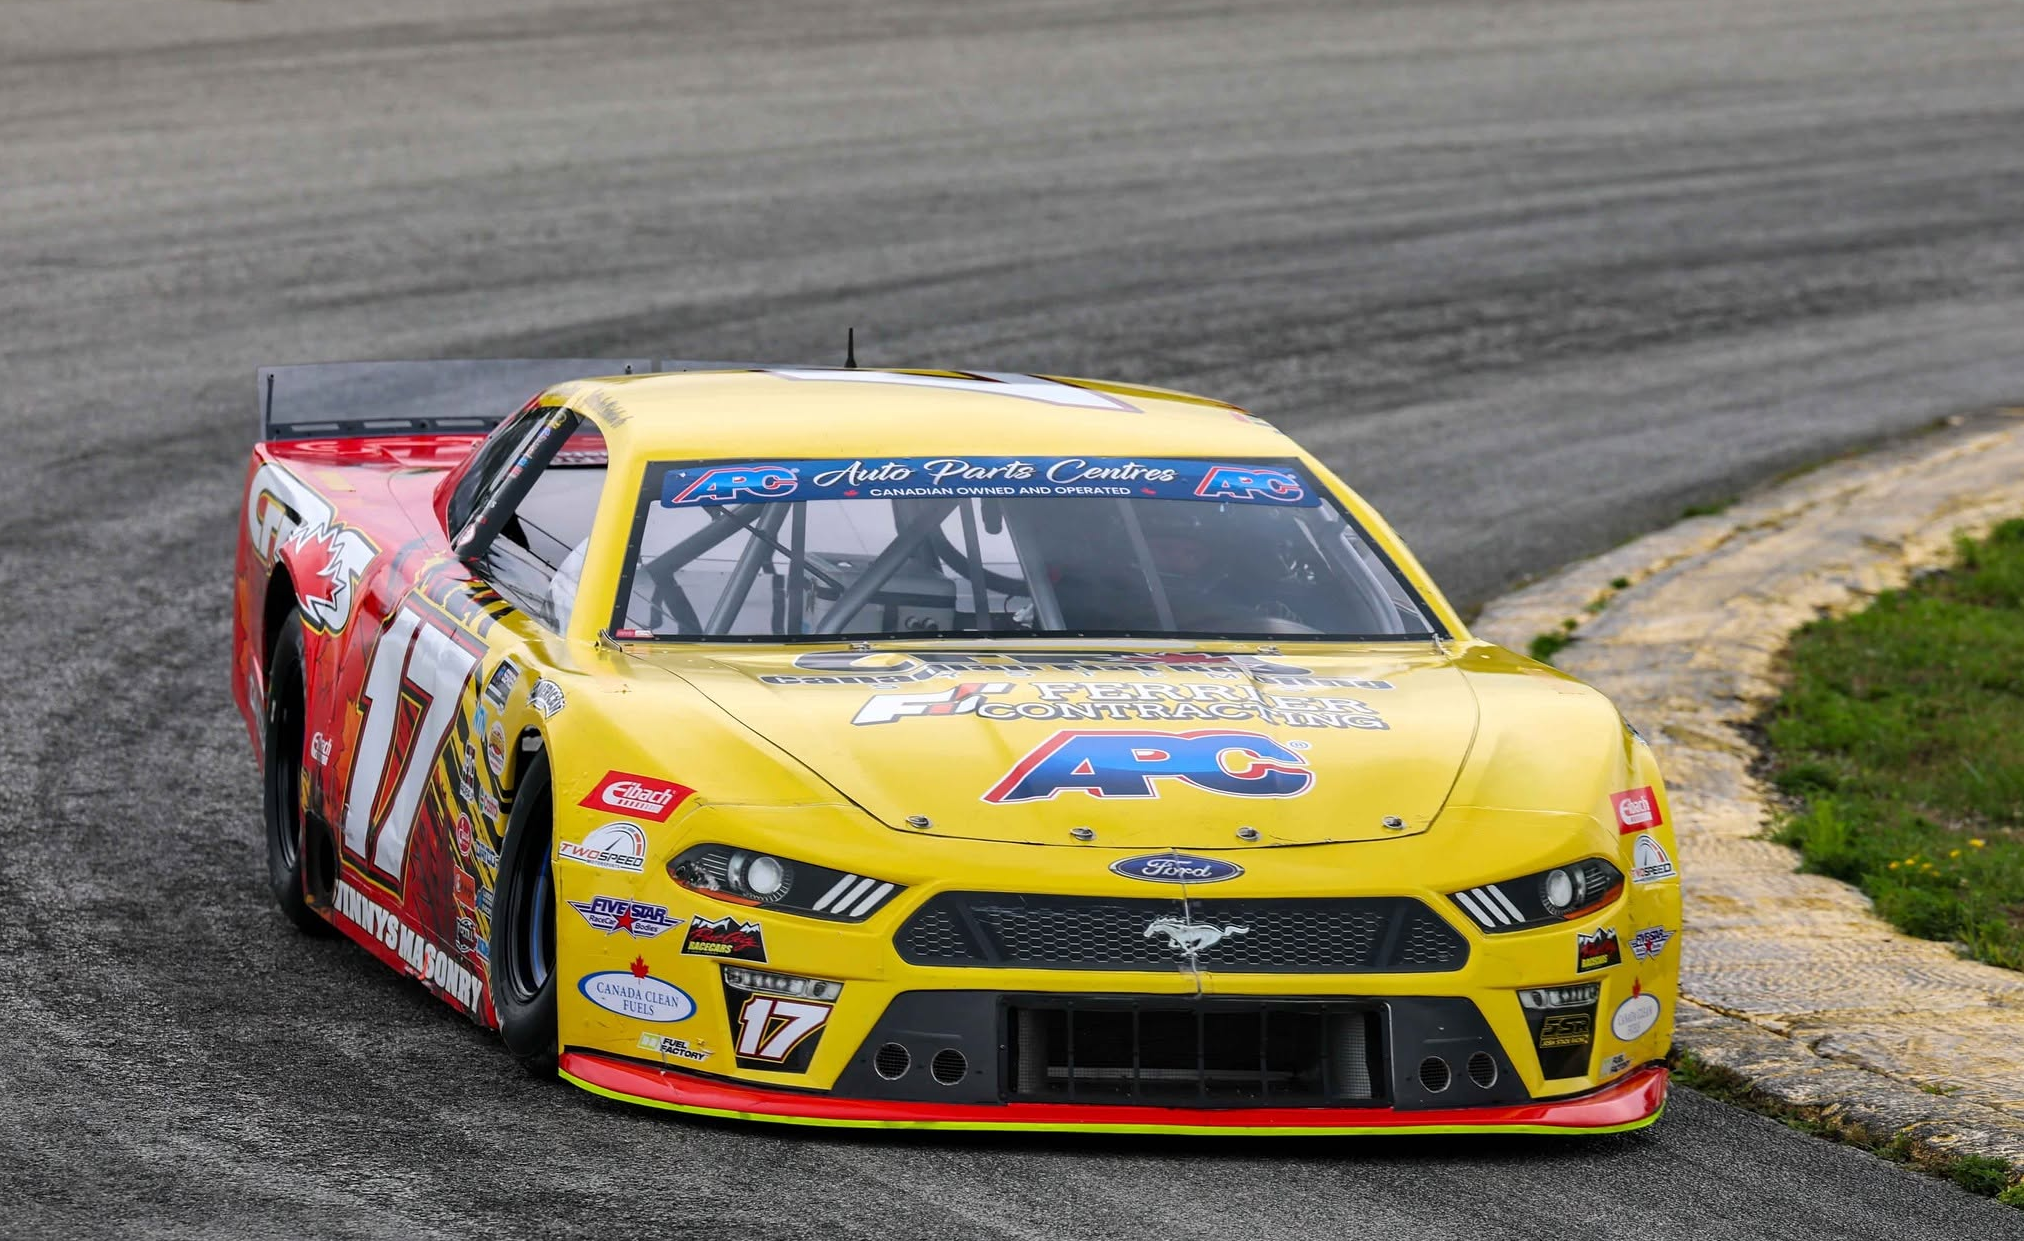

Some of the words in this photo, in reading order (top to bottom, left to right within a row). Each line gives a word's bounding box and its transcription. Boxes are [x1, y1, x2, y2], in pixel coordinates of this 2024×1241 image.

[671, 465, 799, 503] APC
[813, 460, 916, 487] Auto
[923, 459, 1036, 485] Parts
[1046, 458, 1178, 484] Centres
[1194, 466, 1304, 501] APC
[869, 488, 954, 497] CANADIAN
[956, 487, 1015, 496] OWNED
[1019, 486, 1051, 495] AND
[1054, 486, 1131, 495] OPERATED
[1031, 682, 1379, 715] FERRIER
[978, 702, 1390, 730] CONTRACTING
[342, 600, 484, 888] 17
[979, 730, 1315, 804] APC
[601, 780, 676, 814] Eibach
[1141, 858, 1213, 880] Ford
[591, 898, 629, 915] FIVE
[631, 903, 667, 922] STAR
[688, 941, 733, 954] RACECARS
[398, 923, 483, 1013] MASONRY
[596, 982, 642, 1001] CANADA
[645, 991, 679, 1008] CLEAN
[623, 1000, 655, 1016] FUELS
[736, 995, 834, 1061] 17
[660, 1045, 706, 1061] FACTORY
[662, 1037, 687, 1050] FUEL
